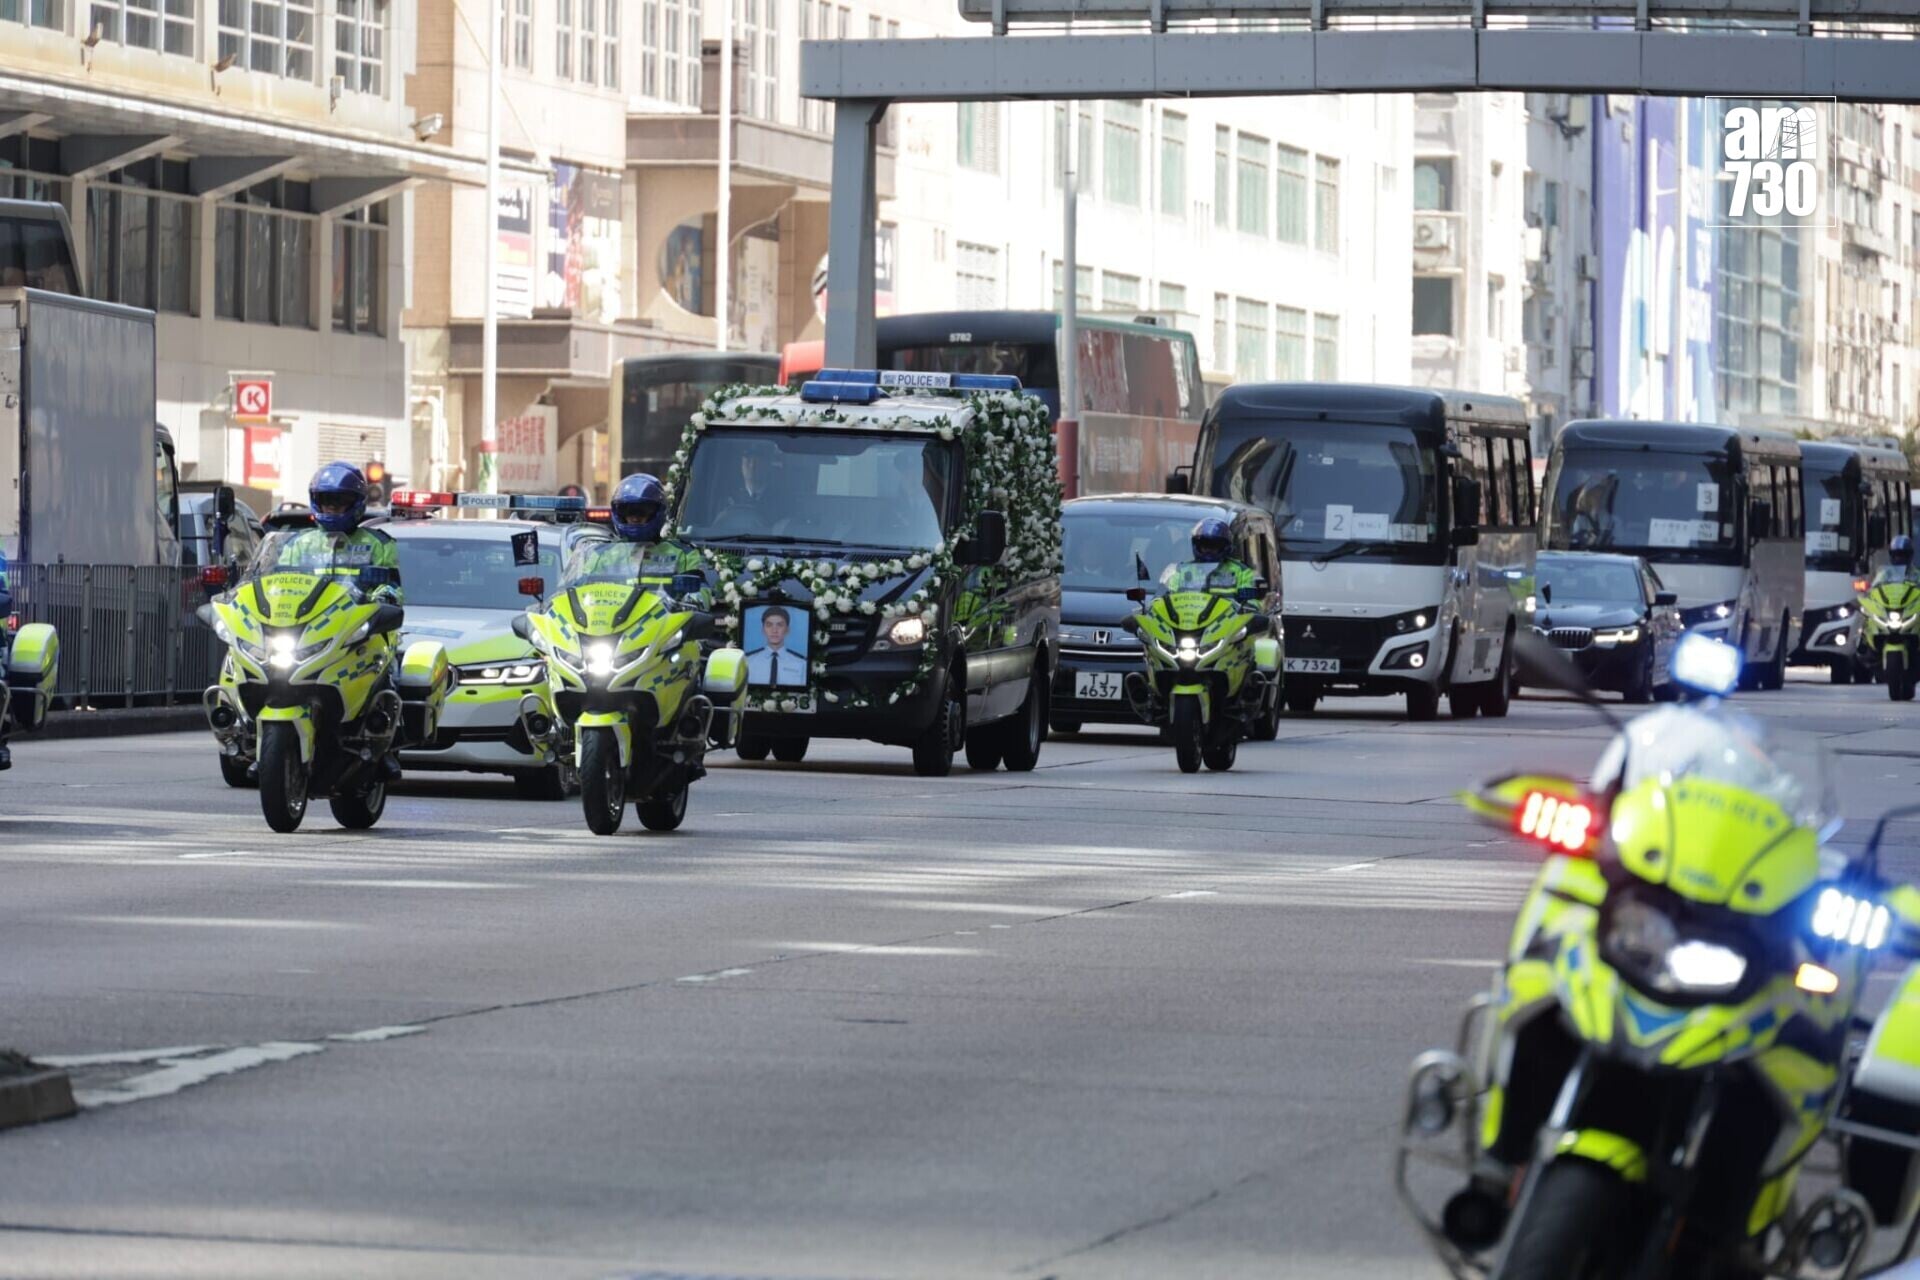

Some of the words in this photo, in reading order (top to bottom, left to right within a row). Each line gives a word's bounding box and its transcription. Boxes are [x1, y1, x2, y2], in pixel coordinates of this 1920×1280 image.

[898, 374, 933, 386] POLICE
[471, 497, 496, 505] POLICE
[1703, 489, 1713, 504] 3
[1332, 514, 1344, 531] 2
[274, 577, 302, 585] POLICE
[1302, 660, 1337, 671] 7324
[1090, 673, 1109, 685] TJ
[1080, 685, 1118, 698] 4637
